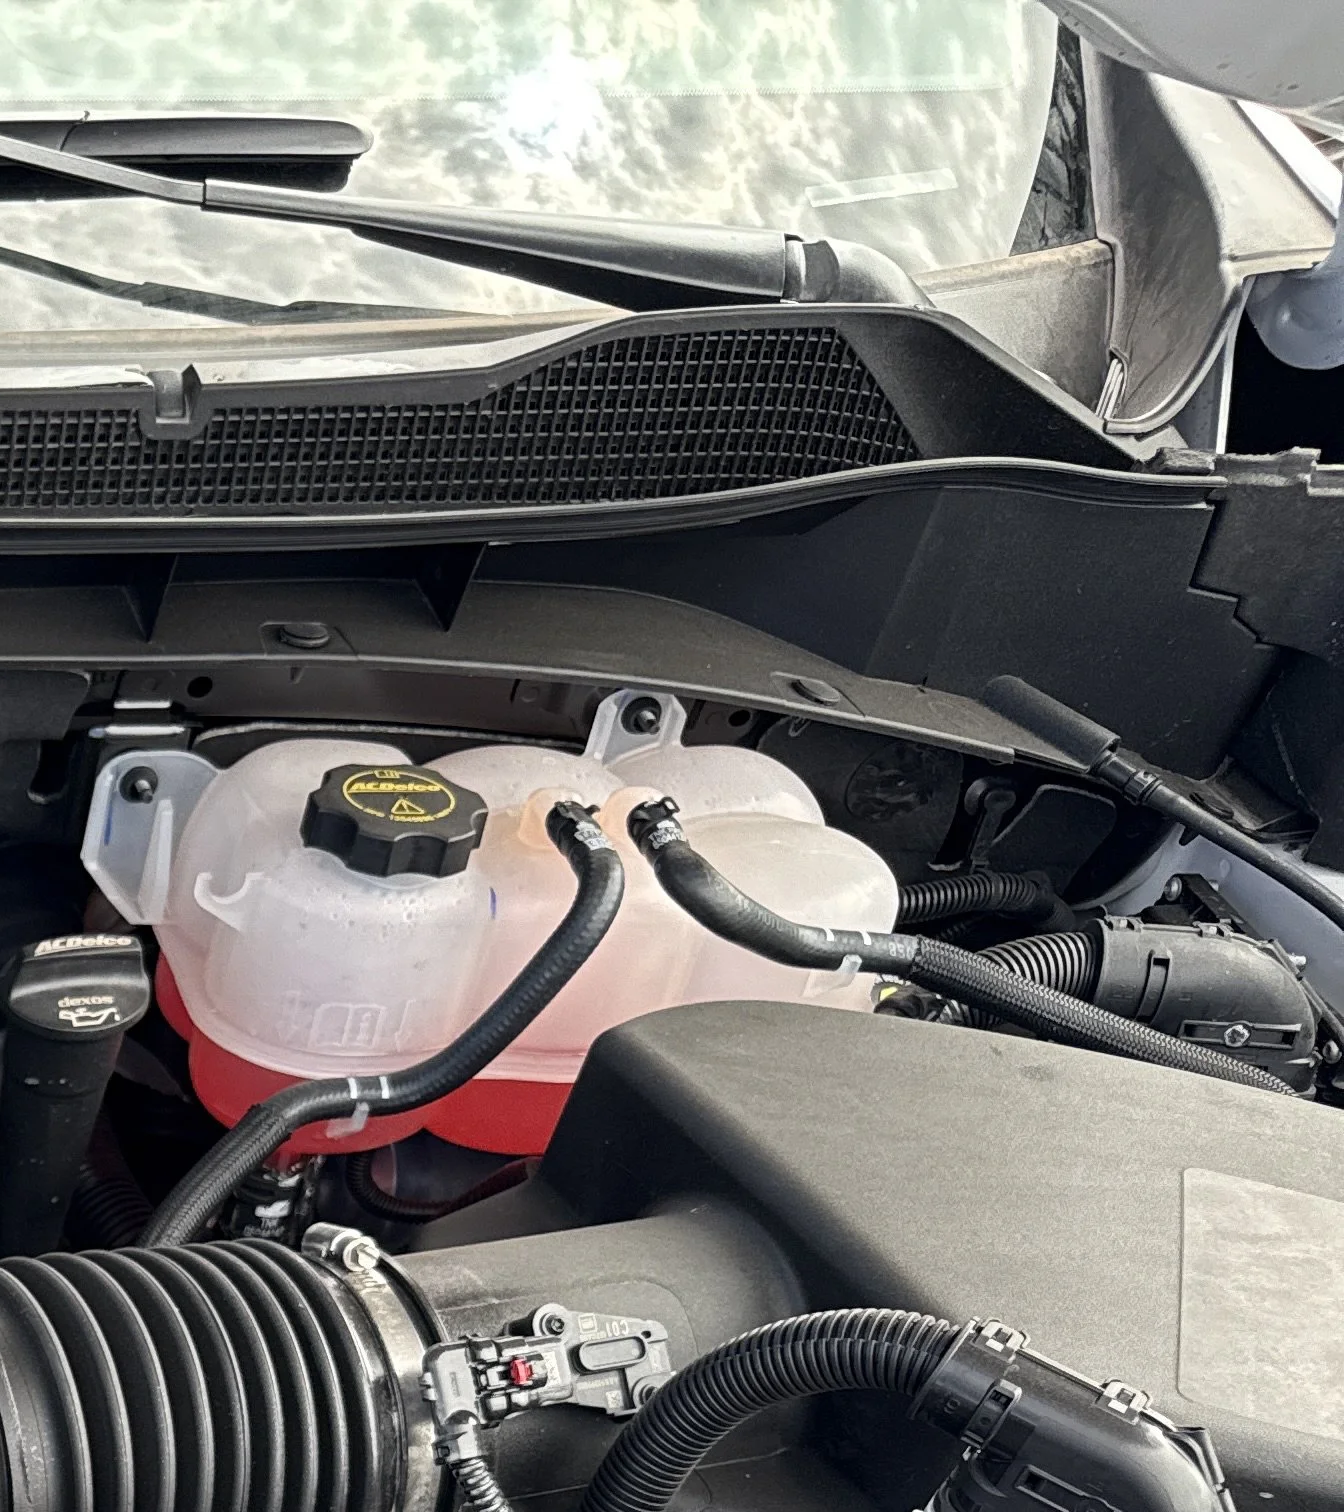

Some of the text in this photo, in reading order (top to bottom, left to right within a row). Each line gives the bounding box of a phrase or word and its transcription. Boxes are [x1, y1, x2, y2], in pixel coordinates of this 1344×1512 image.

[350, 782, 442, 792] ACDelco
[34, 934, 132, 956] ACDelco
[58, 996, 114, 1007] dexos
